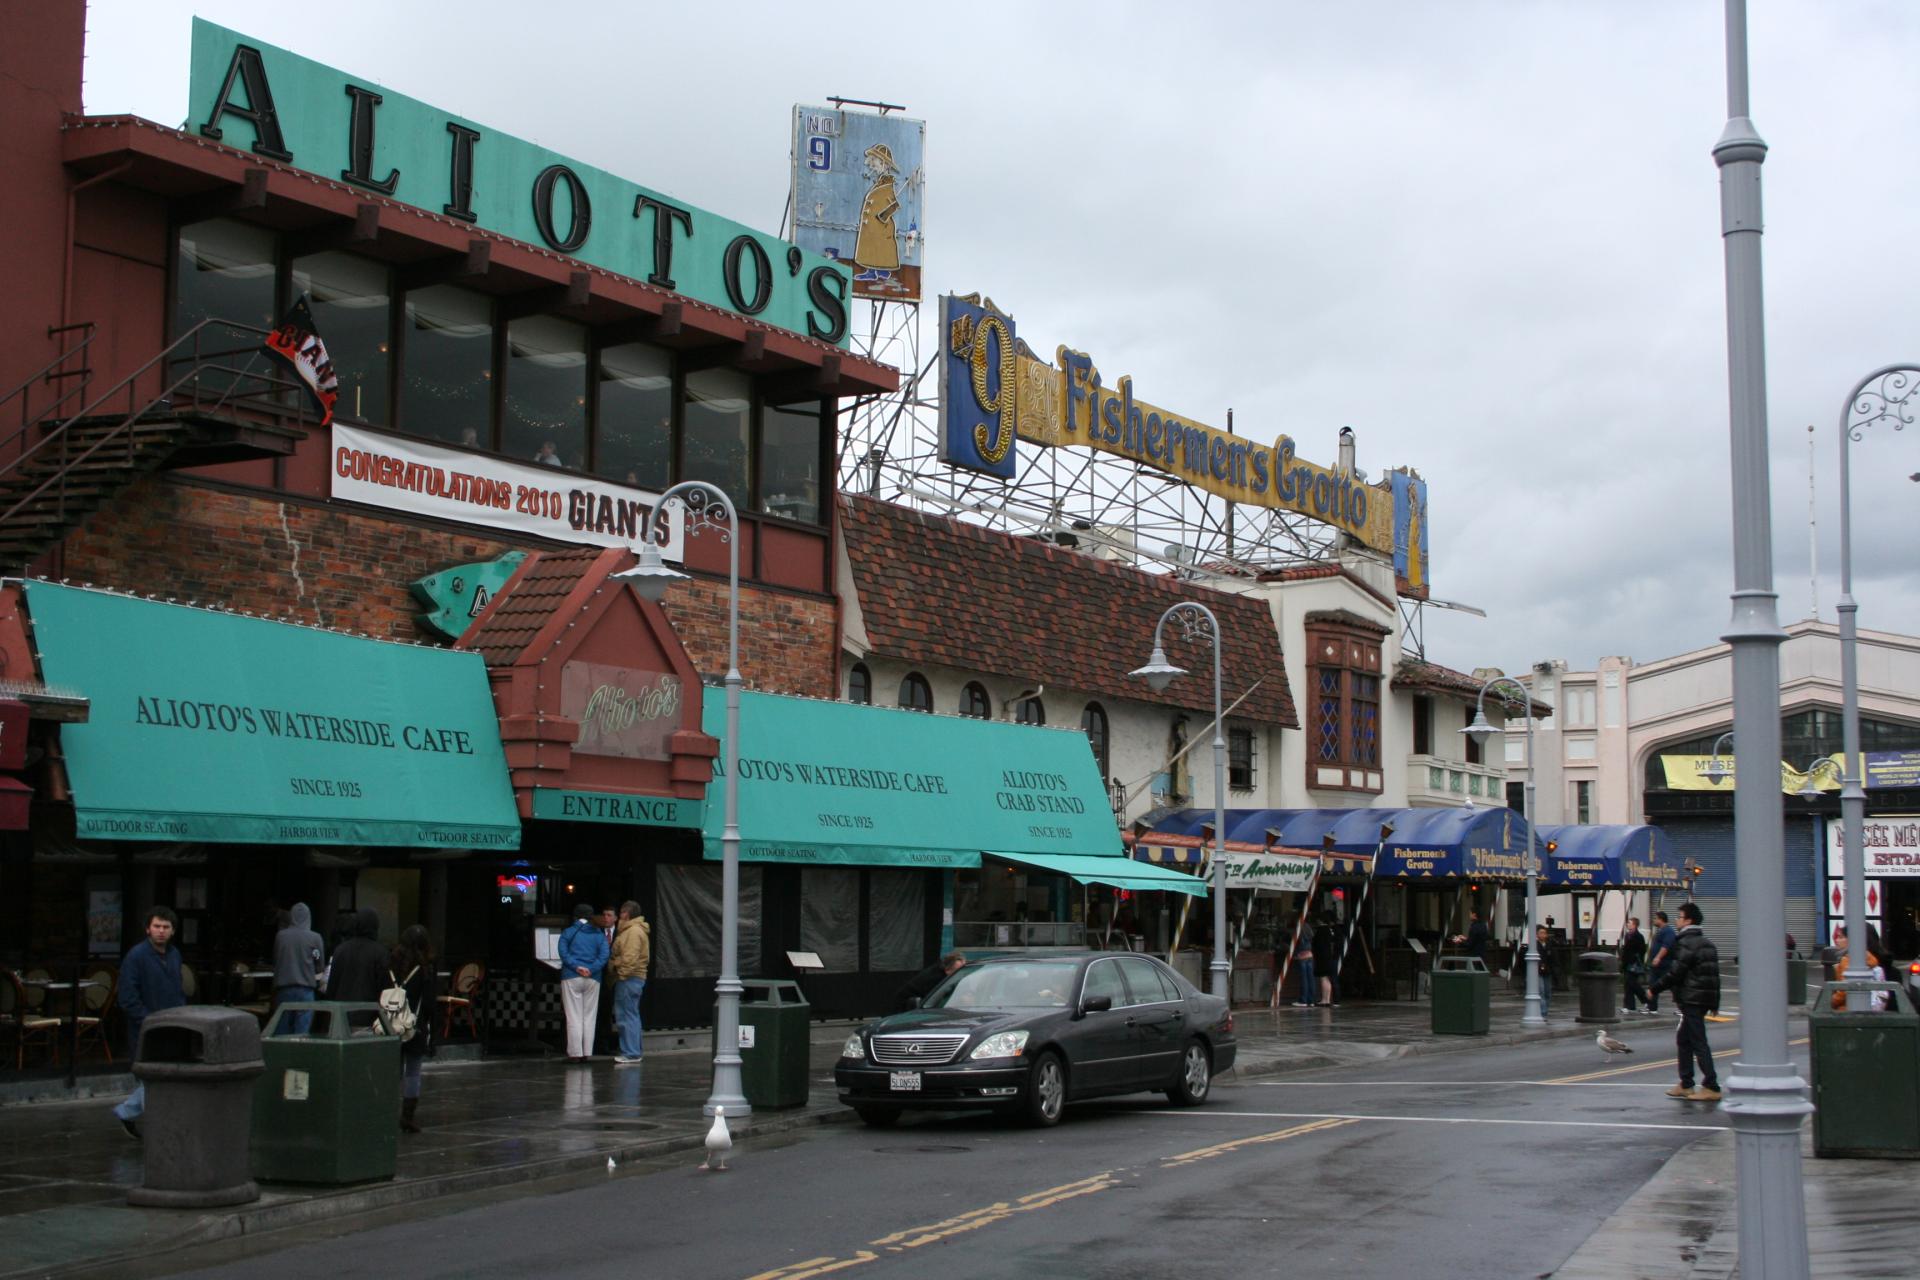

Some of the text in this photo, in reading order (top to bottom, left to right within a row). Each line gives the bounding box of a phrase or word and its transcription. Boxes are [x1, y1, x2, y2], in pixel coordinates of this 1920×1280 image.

[807, 136, 831, 173] 9
[200, 43, 849, 344] ALIOTO'S
[973, 315, 1016, 466] 9
[1056, 344, 1368, 529] Fishermen's Grotto
[336, 446, 671, 548] CONGRATULATIONS 2010 GIANTS
[136, 696, 474, 755] ALIOTO'S WATERSIDE CAFE
[571, 676, 678, 749] Alioto's
[290, 778, 362, 798] SINCE 1925
[795, 763, 902, 791] WATERSIDE
[904, 772, 948, 794] CAFE
[1003, 770, 1067, 792] ALIOTO'S
[562, 795, 678, 822] ENTRANCE
[996, 792, 1085, 815] CRAB STAND
[87, 819, 513, 845] OUTDOOR SEATING HARBOR VIEW OUTDOOR SEATING
[818, 813, 874, 829] SINCE 1925
[1028, 826, 1072, 839] SINCE 1925
[749, 847, 786, 857] OUTDOOR
[1406, 859, 1434, 870] Grotto
[1242, 858, 1315, 881] Anniversary
[1568, 871, 1593, 880] Grotto
